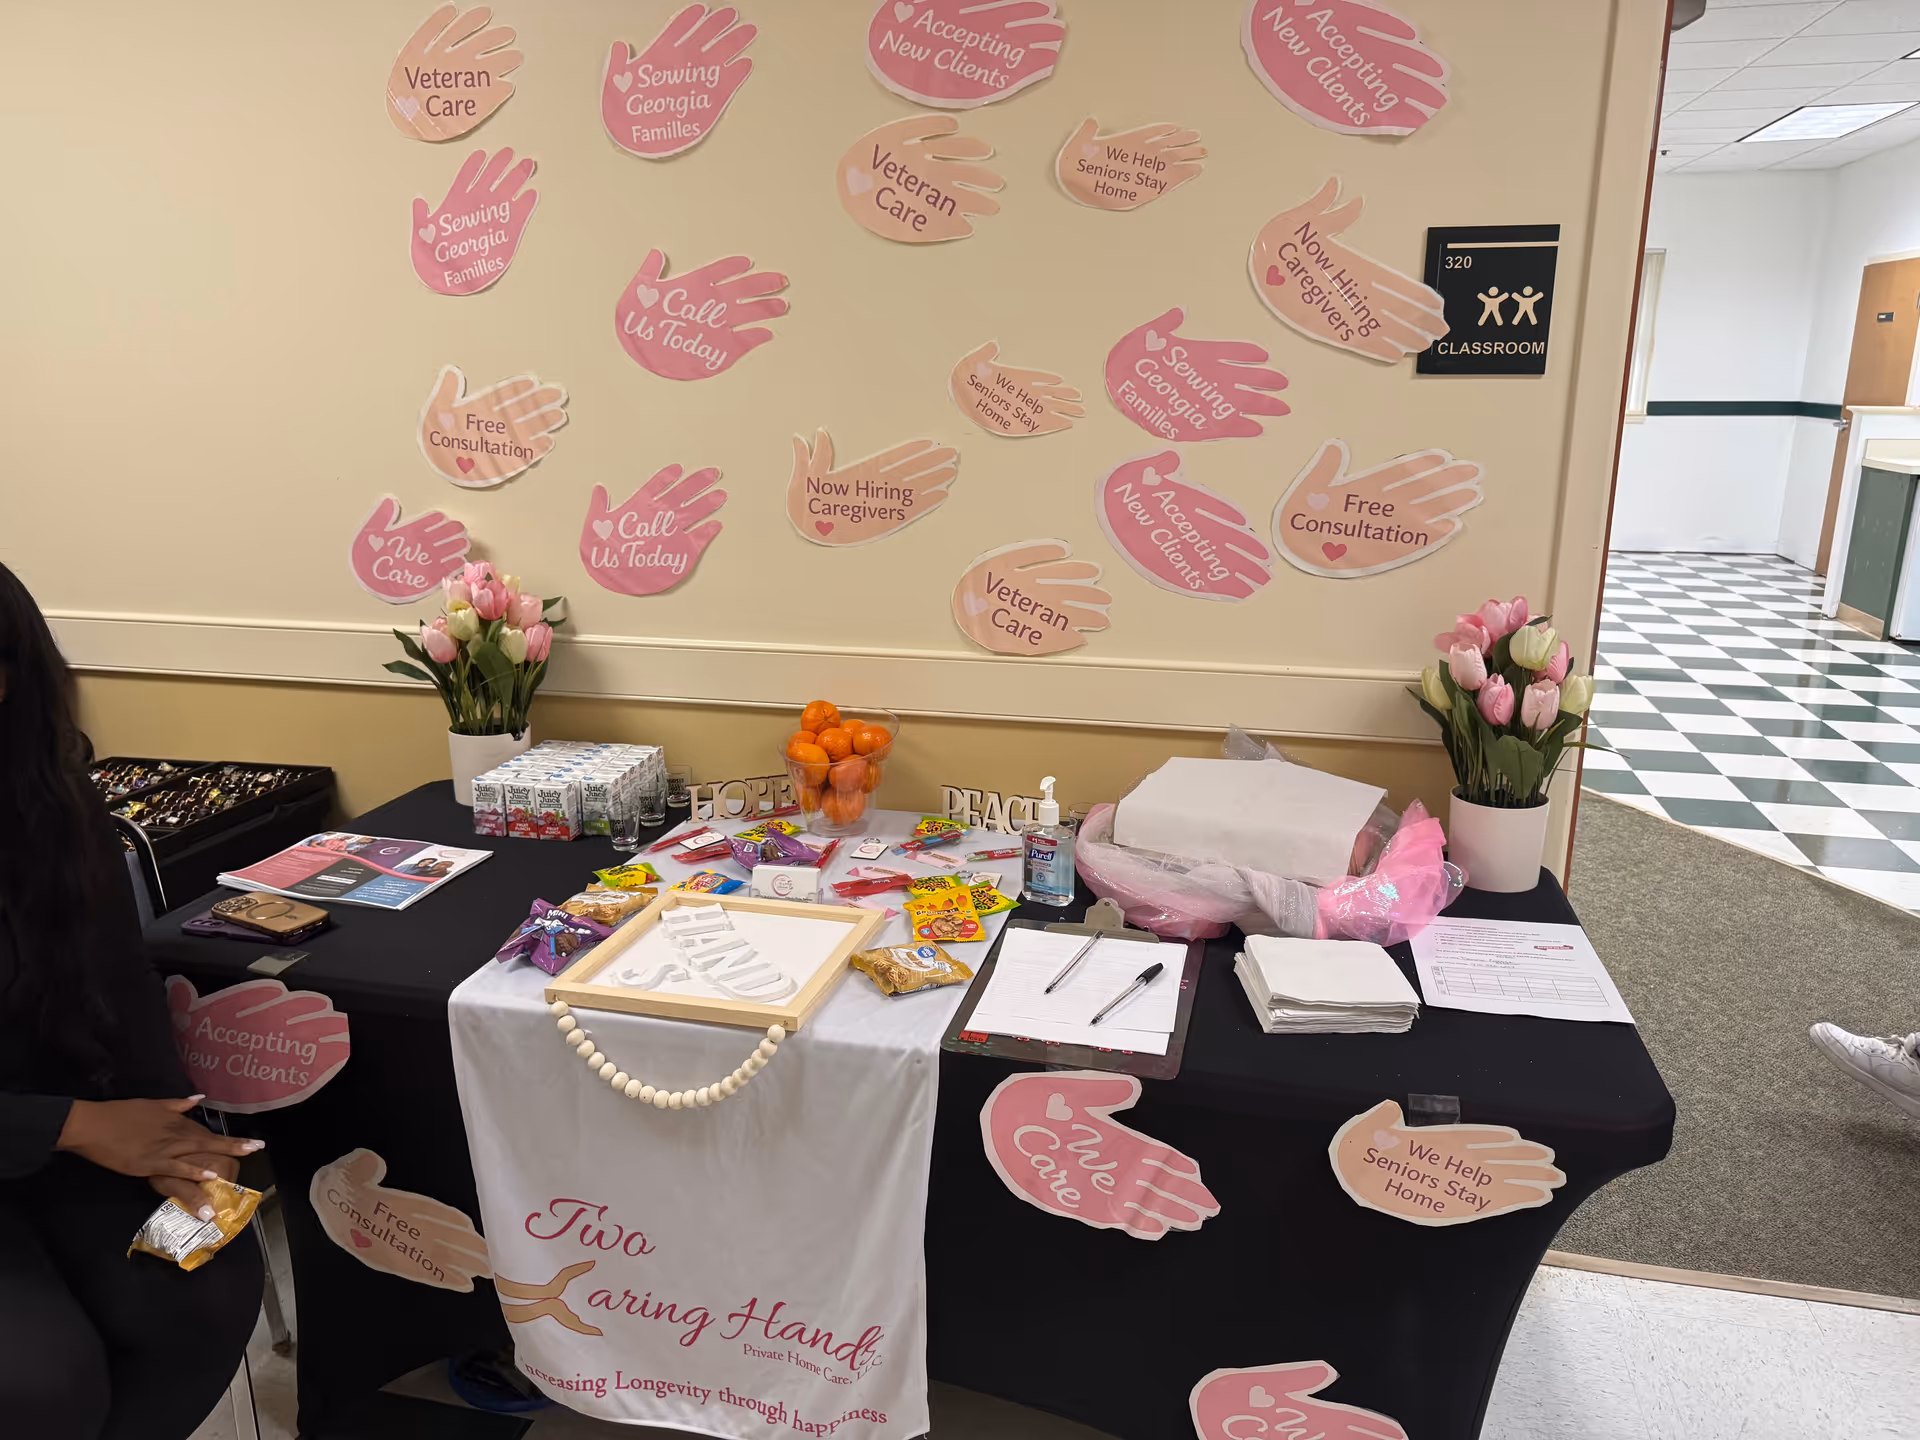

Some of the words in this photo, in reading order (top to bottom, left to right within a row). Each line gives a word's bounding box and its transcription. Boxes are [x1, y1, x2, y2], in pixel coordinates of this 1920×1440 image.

[913, 9, 1026, 69] Accepting
[404, 66, 491, 90] Veteran
[879, 30, 930, 62] New
[934, 47, 1010, 90] Clients
[1262, 7, 1312, 57] New
[1305, 56, 1370, 126] Clients
[1305, 8, 1400, 112] Accepting
[425, 95, 477, 117] Care
[626, 90, 711, 118] Georgia
[1076, 159, 1131, 184] Seniors
[1134, 172, 1168, 195] Stay
[1106, 145, 1129, 163] We
[1132, 151, 1167, 174] Help
[871, 143, 958, 217] Veteran
[1094, 180, 1138, 202] Home
[874, 187, 928, 233] Care
[435, 228, 509, 263] Georgia
[1444, 256, 1472, 270] 320
[1277, 242, 1355, 342] Caregivers
[1293, 221, 1334, 273] Now
[1328, 268, 1381, 338] Hiring
[662, 289, 727, 329] Call
[623, 311, 655, 342] Us
[658, 320, 728, 370] Today
[1437, 341, 1545, 356] CLASSROOM
[966, 373, 1012, 409] Seniors
[1009, 403, 1040, 434] Stay
[995, 372, 1016, 394] We
[1015, 386, 1044, 416] Help
[1135, 358, 1207, 430] Georgia
[465, 413, 506, 435] Free
[975, 398, 1012, 431] Home
[429, 431, 534, 461] Consultation
[806, 476, 850, 497] Now
[855, 479, 914, 507] Hiring
[807, 497, 906, 523] Caregivers
[1343, 493, 1395, 518] Free
[617, 511, 679, 540] Call
[1114, 482, 1155, 526] New
[1150, 527, 1206, 590] Clients
[1151, 490, 1230, 582] Accepting
[1290, 513, 1429, 547] Consultation
[387, 536, 432, 566] We
[590, 546, 620, 570] Us
[620, 542, 689, 575] Today
[372, 556, 429, 588] Care
[985, 571, 1070, 633] Veteran
[991, 607, 1043, 647] Care
[507, 786, 530, 795] Juicy
[538, 790, 561, 799] Juicy
[685, 774, 799, 823] HOPE
[547, 909, 569, 920] MINI
[195, 1016, 317, 1065] Accepting
[226, 1054, 309, 1086] Clients
[1012, 1124, 1082, 1210] Care
[1066, 1123, 1118, 1196] We
[1406, 1139, 1440, 1166] We
[1444, 1151, 1493, 1189] Help
[1362, 1146, 1439, 1188] Seniors
[1444, 1176, 1491, 1214] Stay
[1384, 1178, 1446, 1214] Home
[327, 1188, 445, 1282] Consultation
[373, 1201, 421, 1240] Free
[525, 1198, 656, 1257] Two
[743, 1343, 784, 1361] Private
[787, 1350, 821, 1376] Home
[523, 1362, 608, 1399] ncreasing
[614, 1370, 712, 1406] Longevity
[718, 1387, 788, 1425] through
[792, 1407, 888, 1438] happiness
[1275, 1407, 1325, 1440] W
